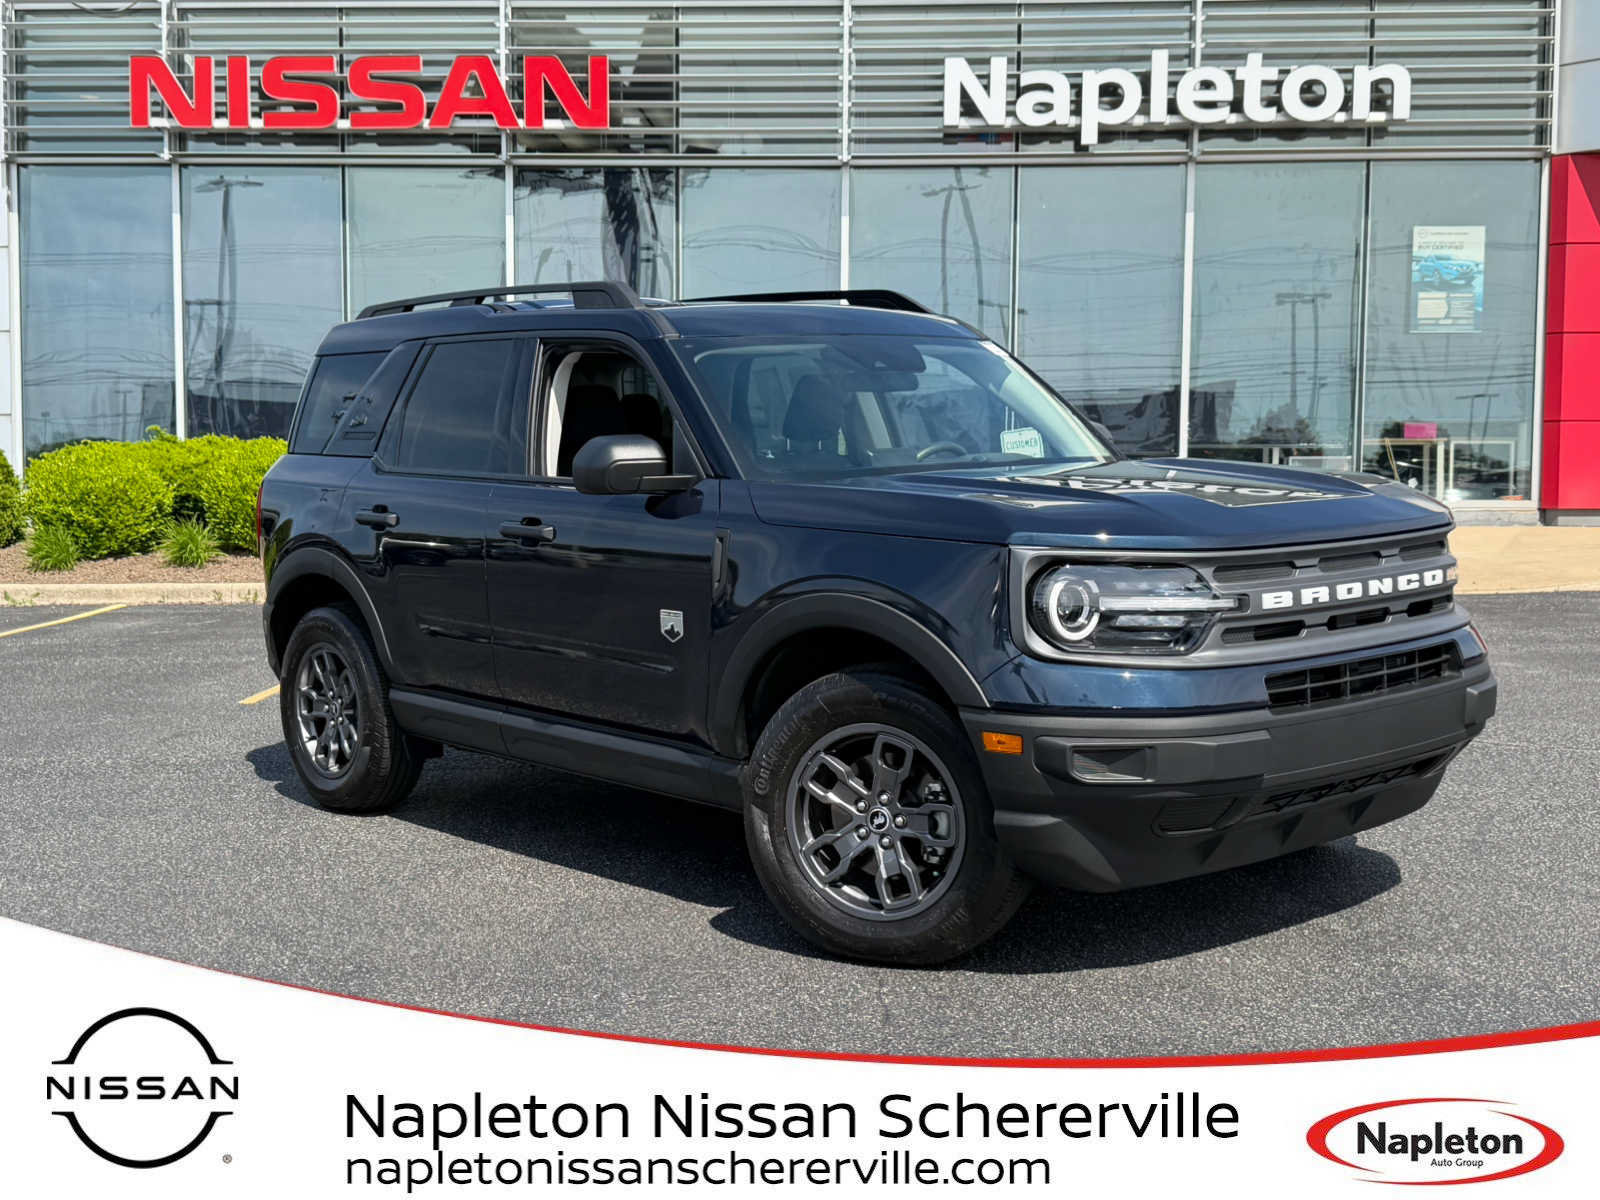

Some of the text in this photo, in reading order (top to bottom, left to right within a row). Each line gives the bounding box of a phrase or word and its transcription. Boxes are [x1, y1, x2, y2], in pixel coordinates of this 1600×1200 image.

[129, 55, 609, 129] NISSAN
[943, 49, 1412, 146] Napleton
[1006, 437, 1039, 449] CUSTOMER
[1261, 568, 1444, 610] BRONCO
